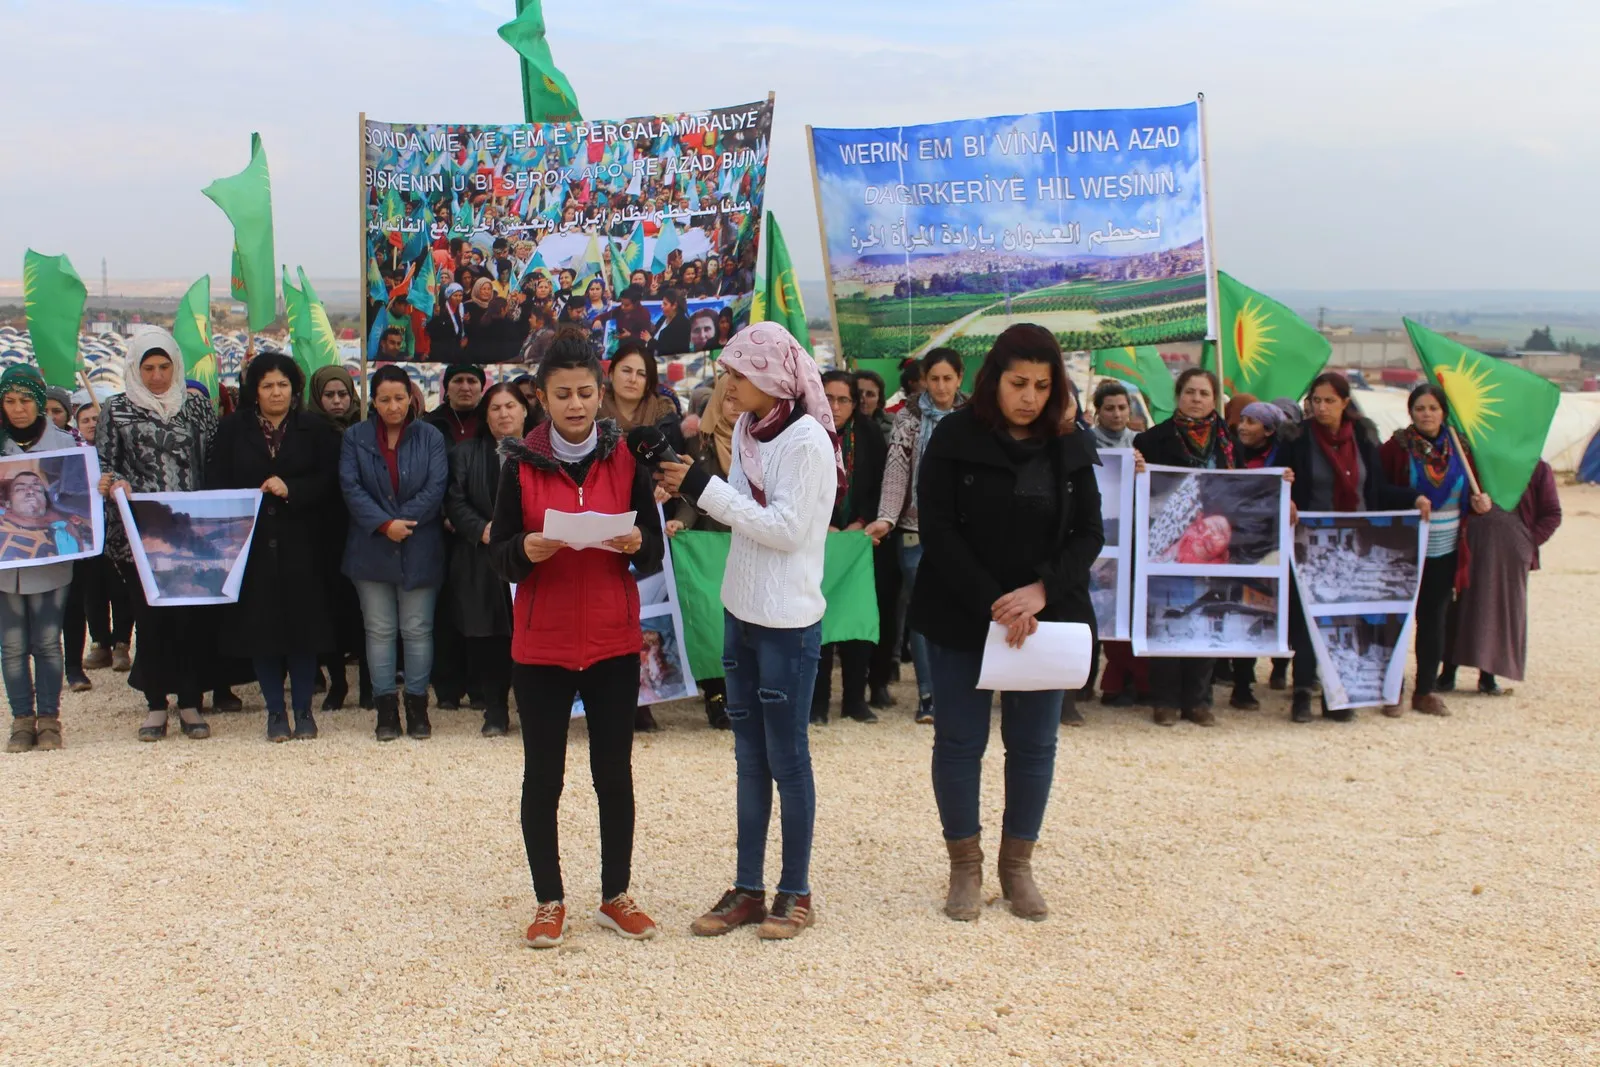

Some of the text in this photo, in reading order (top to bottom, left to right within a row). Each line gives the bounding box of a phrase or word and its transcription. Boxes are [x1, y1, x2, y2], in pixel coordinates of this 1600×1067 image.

[430, 133, 461, 151] ME
[512, 129, 544, 148] EM
[576, 124, 672, 143] PERGALA
[839, 142, 909, 165] WERIN
[919, 137, 953, 160] EM
[963, 135, 986, 157] BI
[1067, 130, 1119, 153] JINA
[1128, 126, 1180, 150] AZAD
[475, 174, 493, 190] BI
[502, 169, 573, 190] SEROK
[580, 163, 623, 181] APO
[666, 154, 715, 175] AZAD
[1037, 177, 1075, 200] HIL
[611, 205, 649, 228] نظام
[654, 203, 718, 228] سنحطم
[720, 198, 751, 215] وعدنا
[430, 221, 449, 239] مع
[454, 216, 495, 237] الحرية
[500, 213, 555, 237] ونعيش
[851, 217, 1161, 254] لنحطم العدوان بإرادة المرأة الحرة
